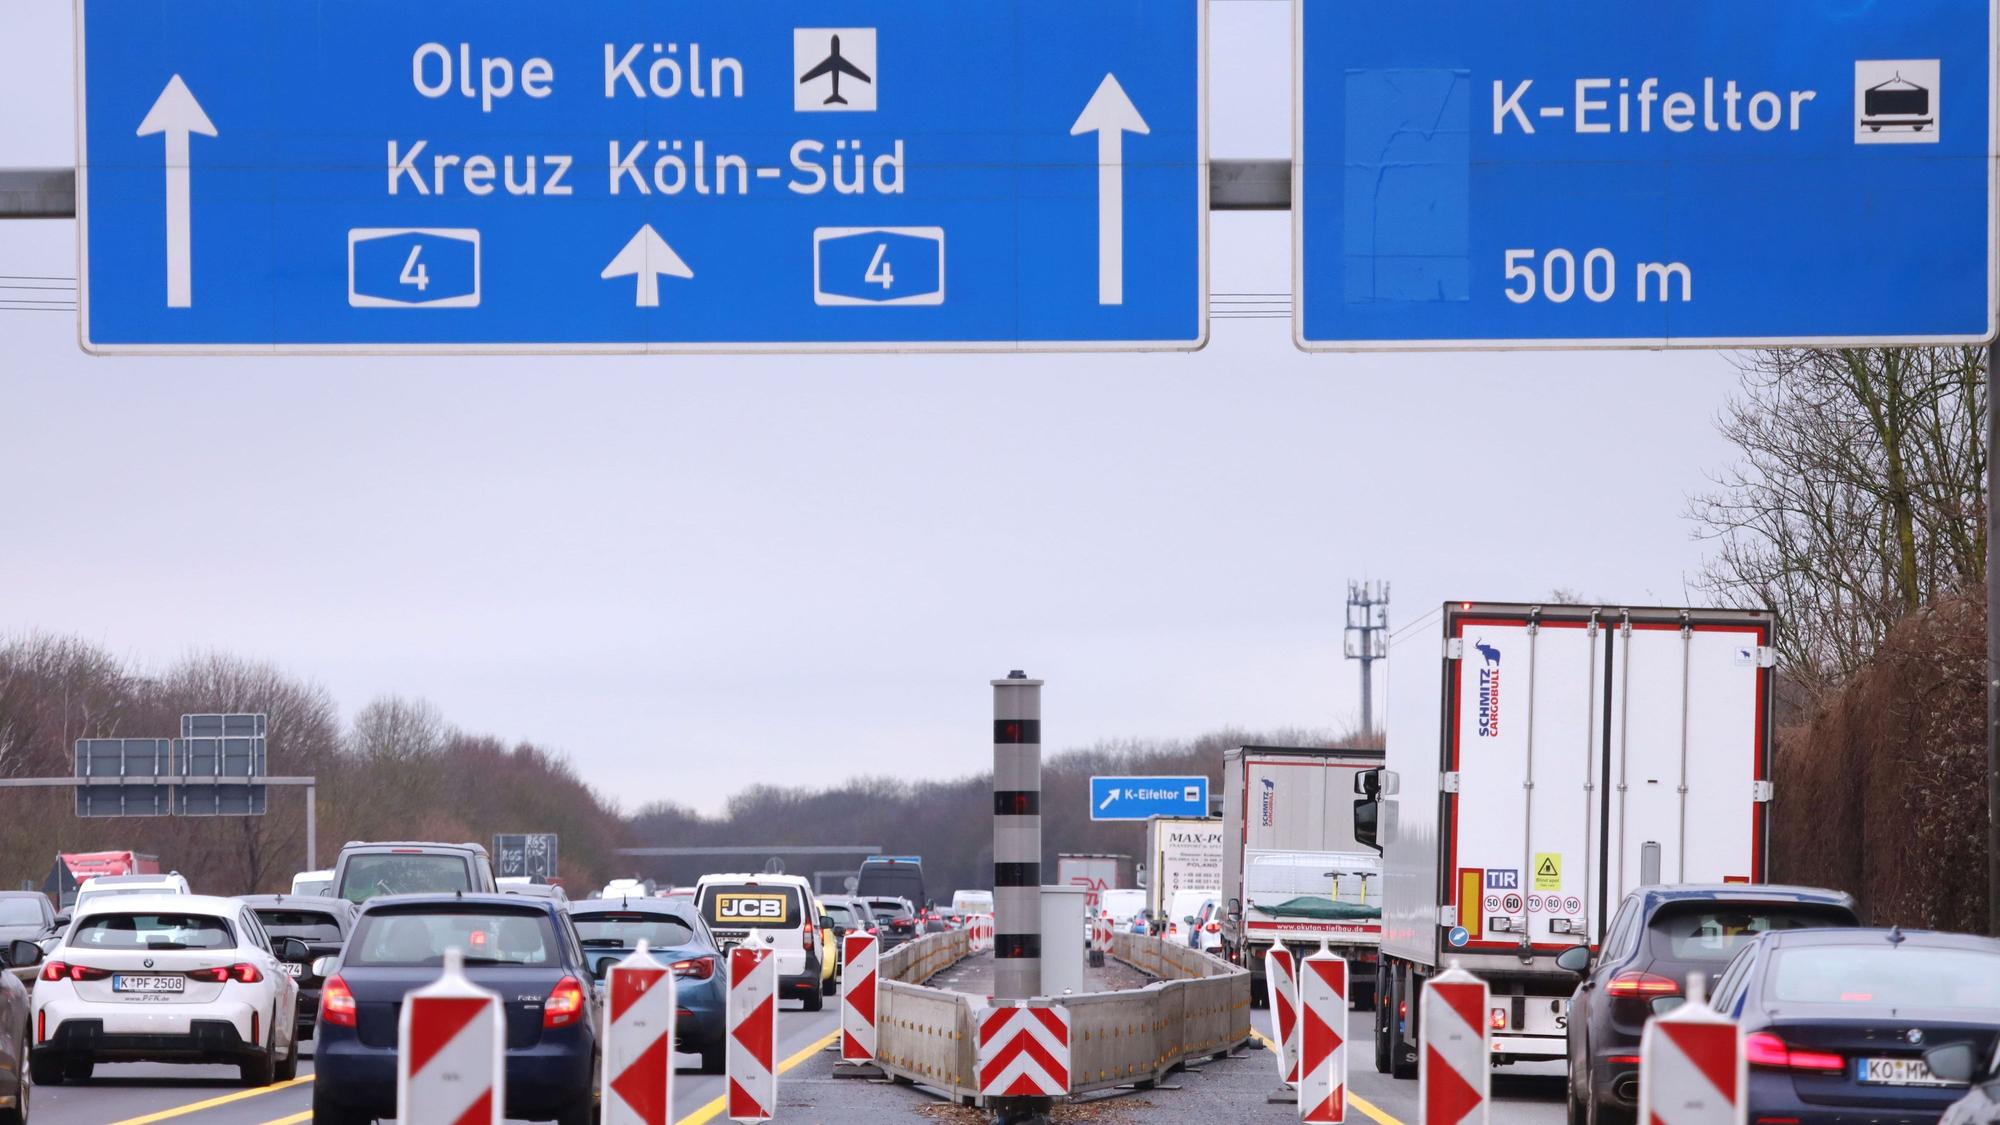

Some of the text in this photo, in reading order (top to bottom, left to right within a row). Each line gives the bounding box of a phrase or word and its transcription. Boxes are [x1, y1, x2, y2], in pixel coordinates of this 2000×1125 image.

[412, 42, 744, 112] Olpe Köln
[1493, 76, 1816, 134] K-Eifeltor
[386, 138, 904, 196] Kreuz Köln-Süd
[399, 244, 430, 291] 4
[863, 243, 895, 289] 4
[1504, 247, 1693, 304] 500 m
[1479, 668, 1491, 737] SCHMITZ
[1490, 668, 1500, 737] CARGOBULL
[1124, 788, 1180, 801] K-Eifeltor
[1487, 871, 1516, 888] TIR
[721, 899, 781, 917] JCB
[1486, 898, 1578, 909] 50 60 70 80 90
[120, 977, 182, 989] K PF 2508
[1868, 1061, 1894, 1079] KO
